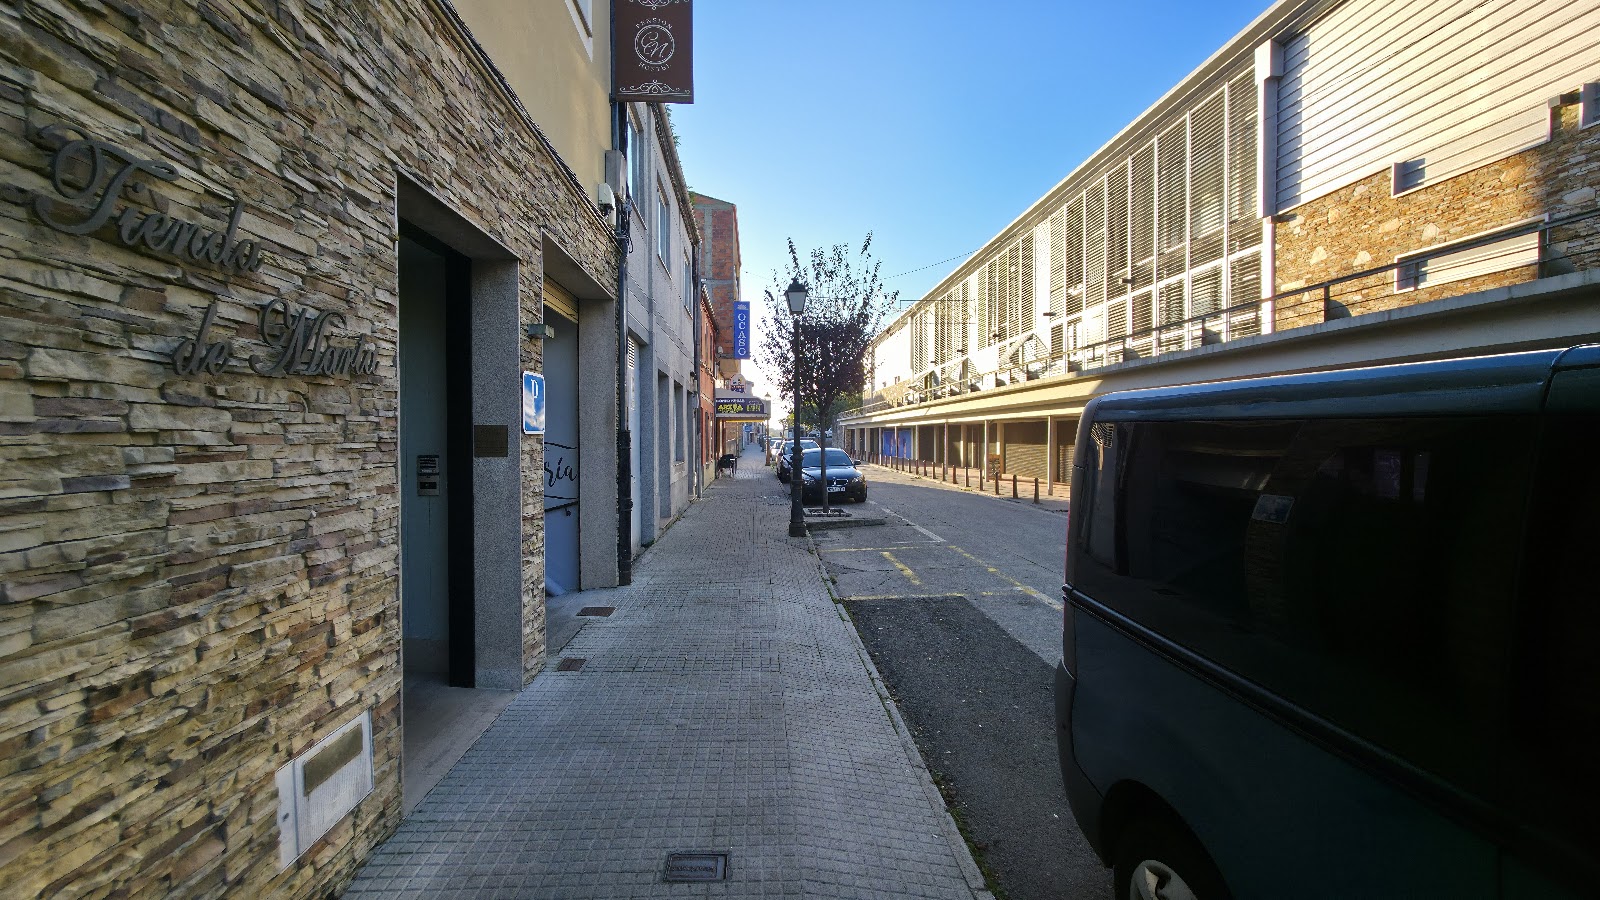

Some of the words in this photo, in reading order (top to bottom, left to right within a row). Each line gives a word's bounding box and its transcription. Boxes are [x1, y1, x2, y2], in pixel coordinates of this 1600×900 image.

[34, 123, 265, 273] Tienda
[171, 303, 231, 376] de
[737, 312, 747, 356] OCASO
